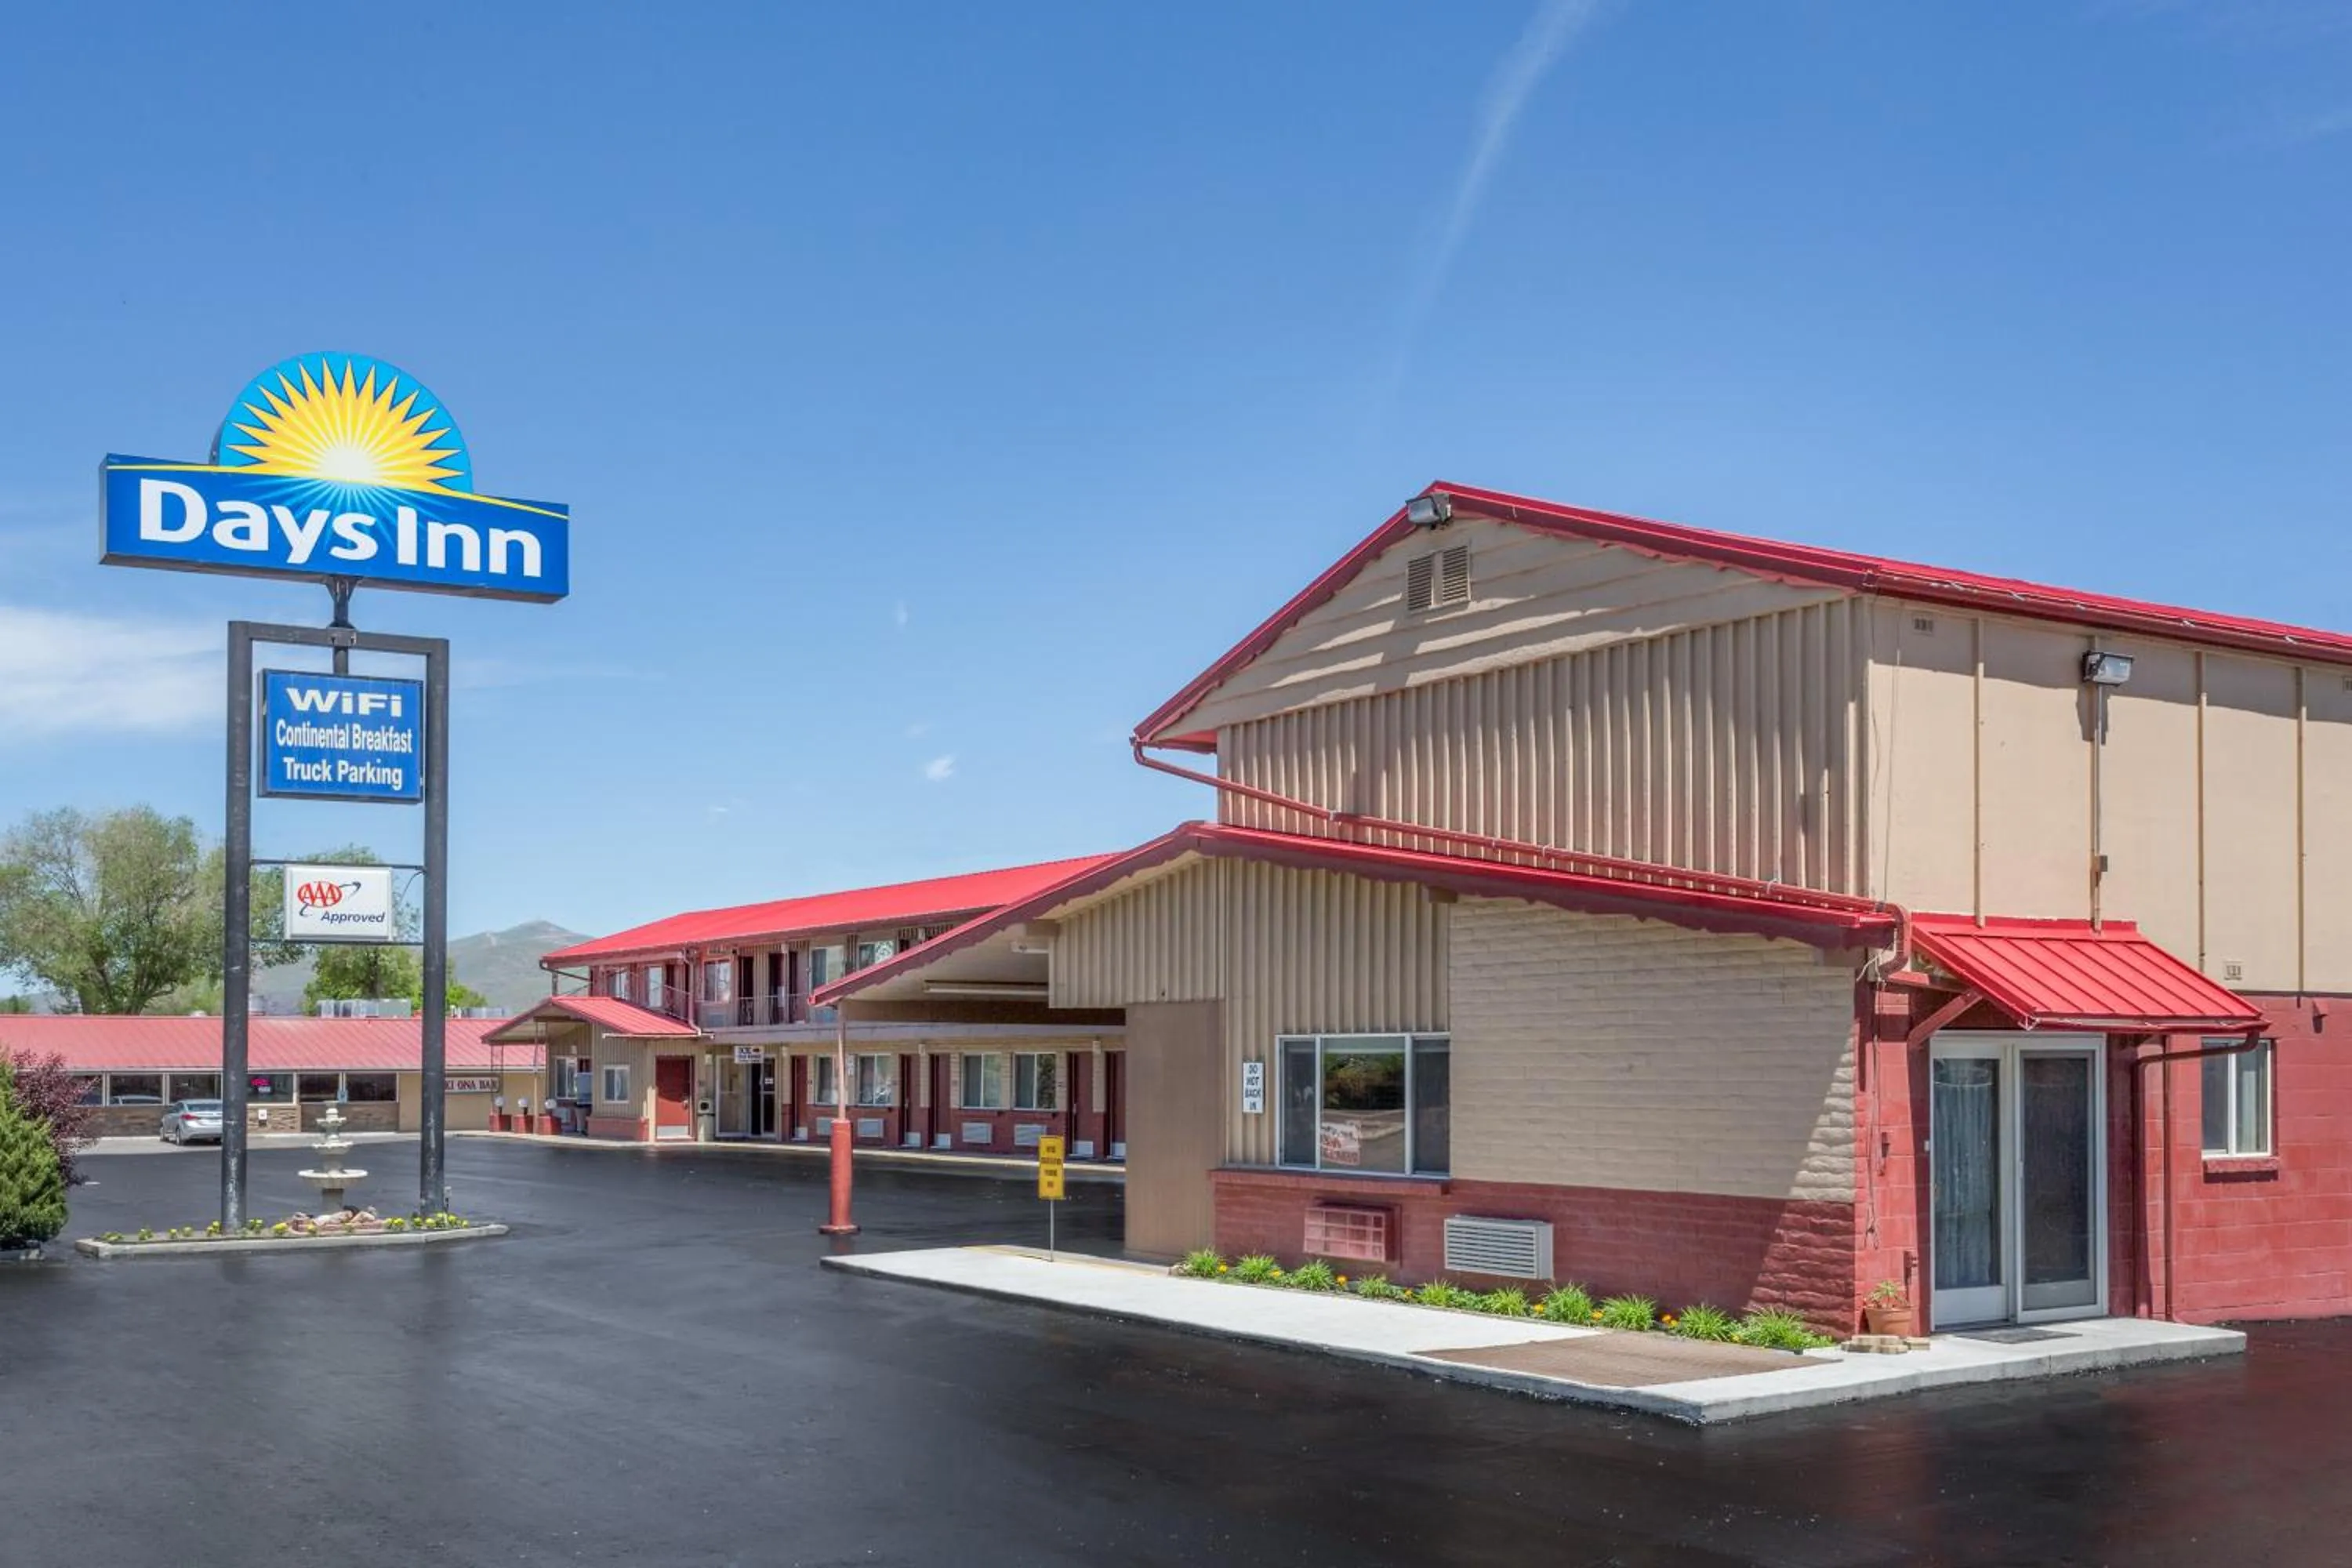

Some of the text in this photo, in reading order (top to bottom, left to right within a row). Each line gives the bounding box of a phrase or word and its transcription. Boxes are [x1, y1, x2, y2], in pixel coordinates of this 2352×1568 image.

[140, 477, 543, 578] Days Inn
[286, 688, 402, 717] WiFi
[276, 719, 412, 753] Continental Breakfast
[283, 757, 402, 791] Truck Parking
[299, 881, 340, 907] AAA
[321, 911, 386, 924] Approved
[1245, 1088, 1261, 1098] BACK
[1247, 1076, 1260, 1086] NOT
